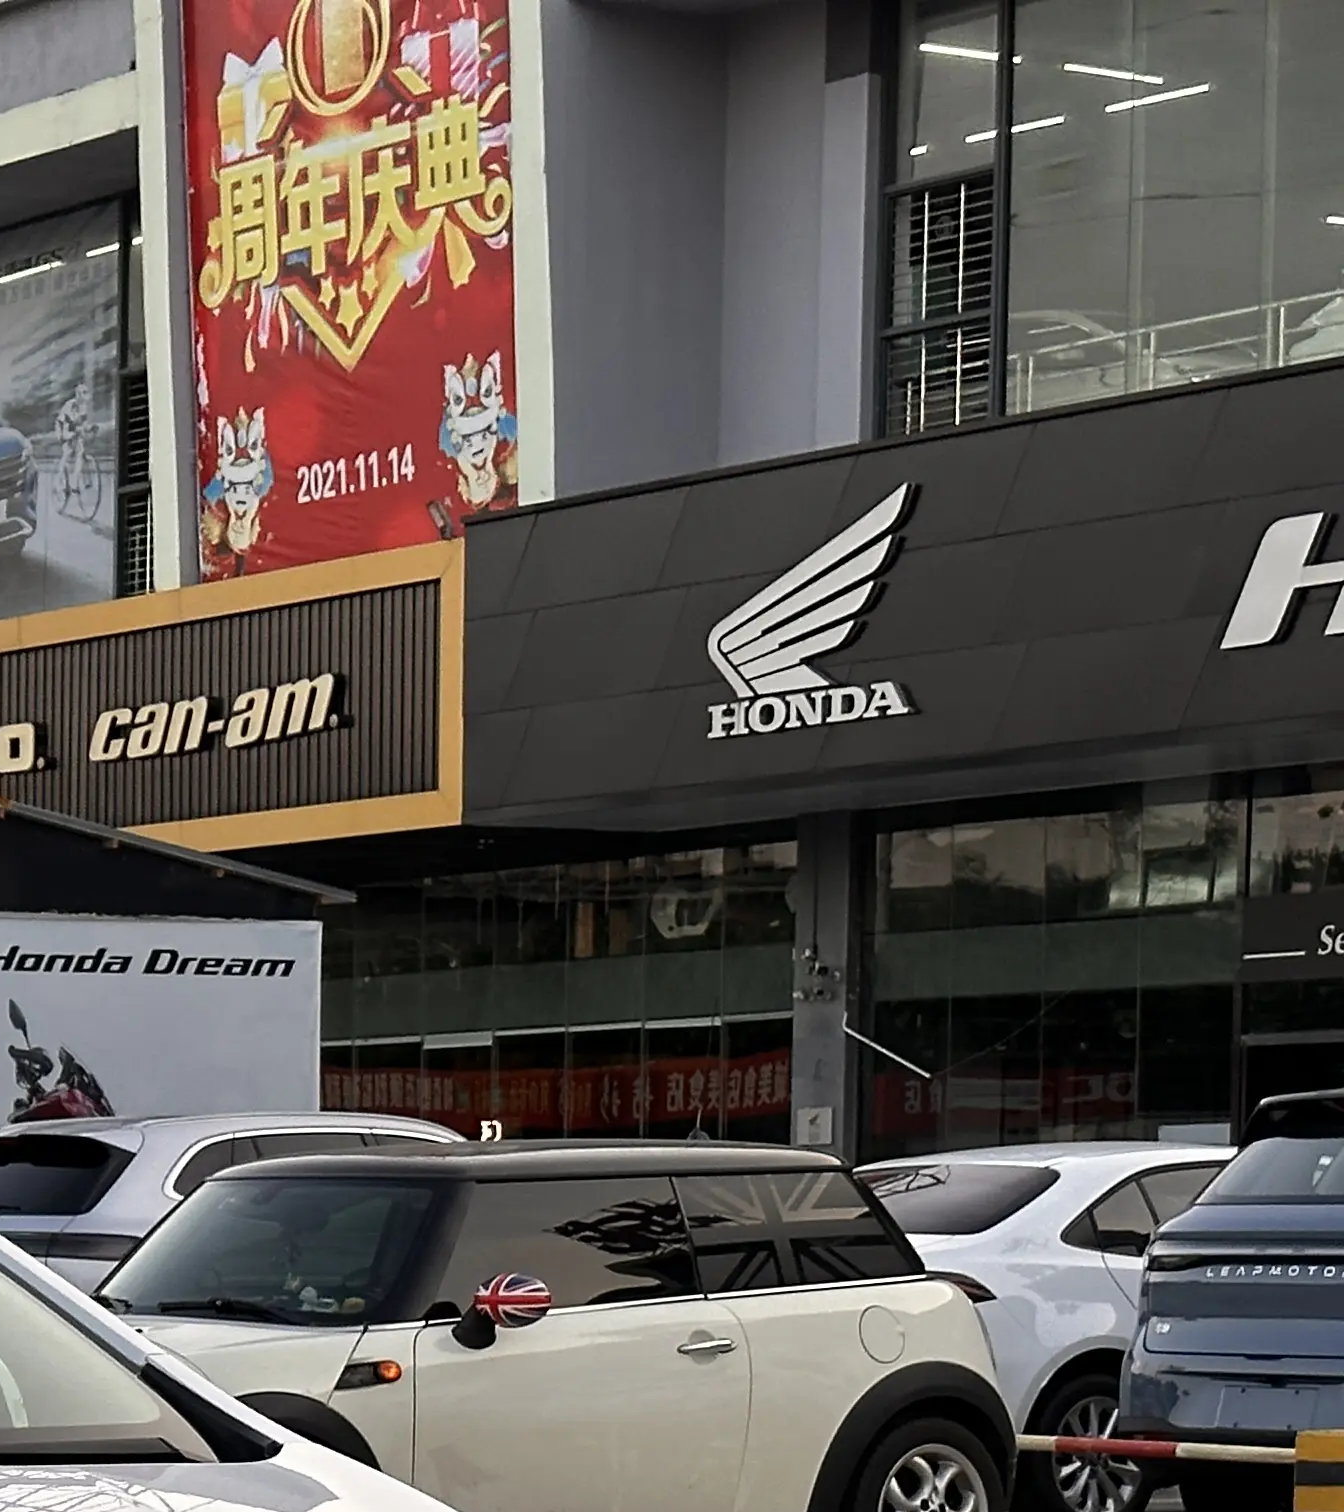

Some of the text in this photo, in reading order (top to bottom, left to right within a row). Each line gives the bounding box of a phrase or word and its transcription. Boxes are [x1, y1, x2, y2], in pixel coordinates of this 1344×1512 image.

[199, 94, 511, 309] 周年庆典
[296, 443, 415, 504] 2021.11.14
[707, 681, 909, 739] HONDA
[142, 948, 296, 977] Dream
[1206, 1265, 1344, 1278] LEAPMOTO
